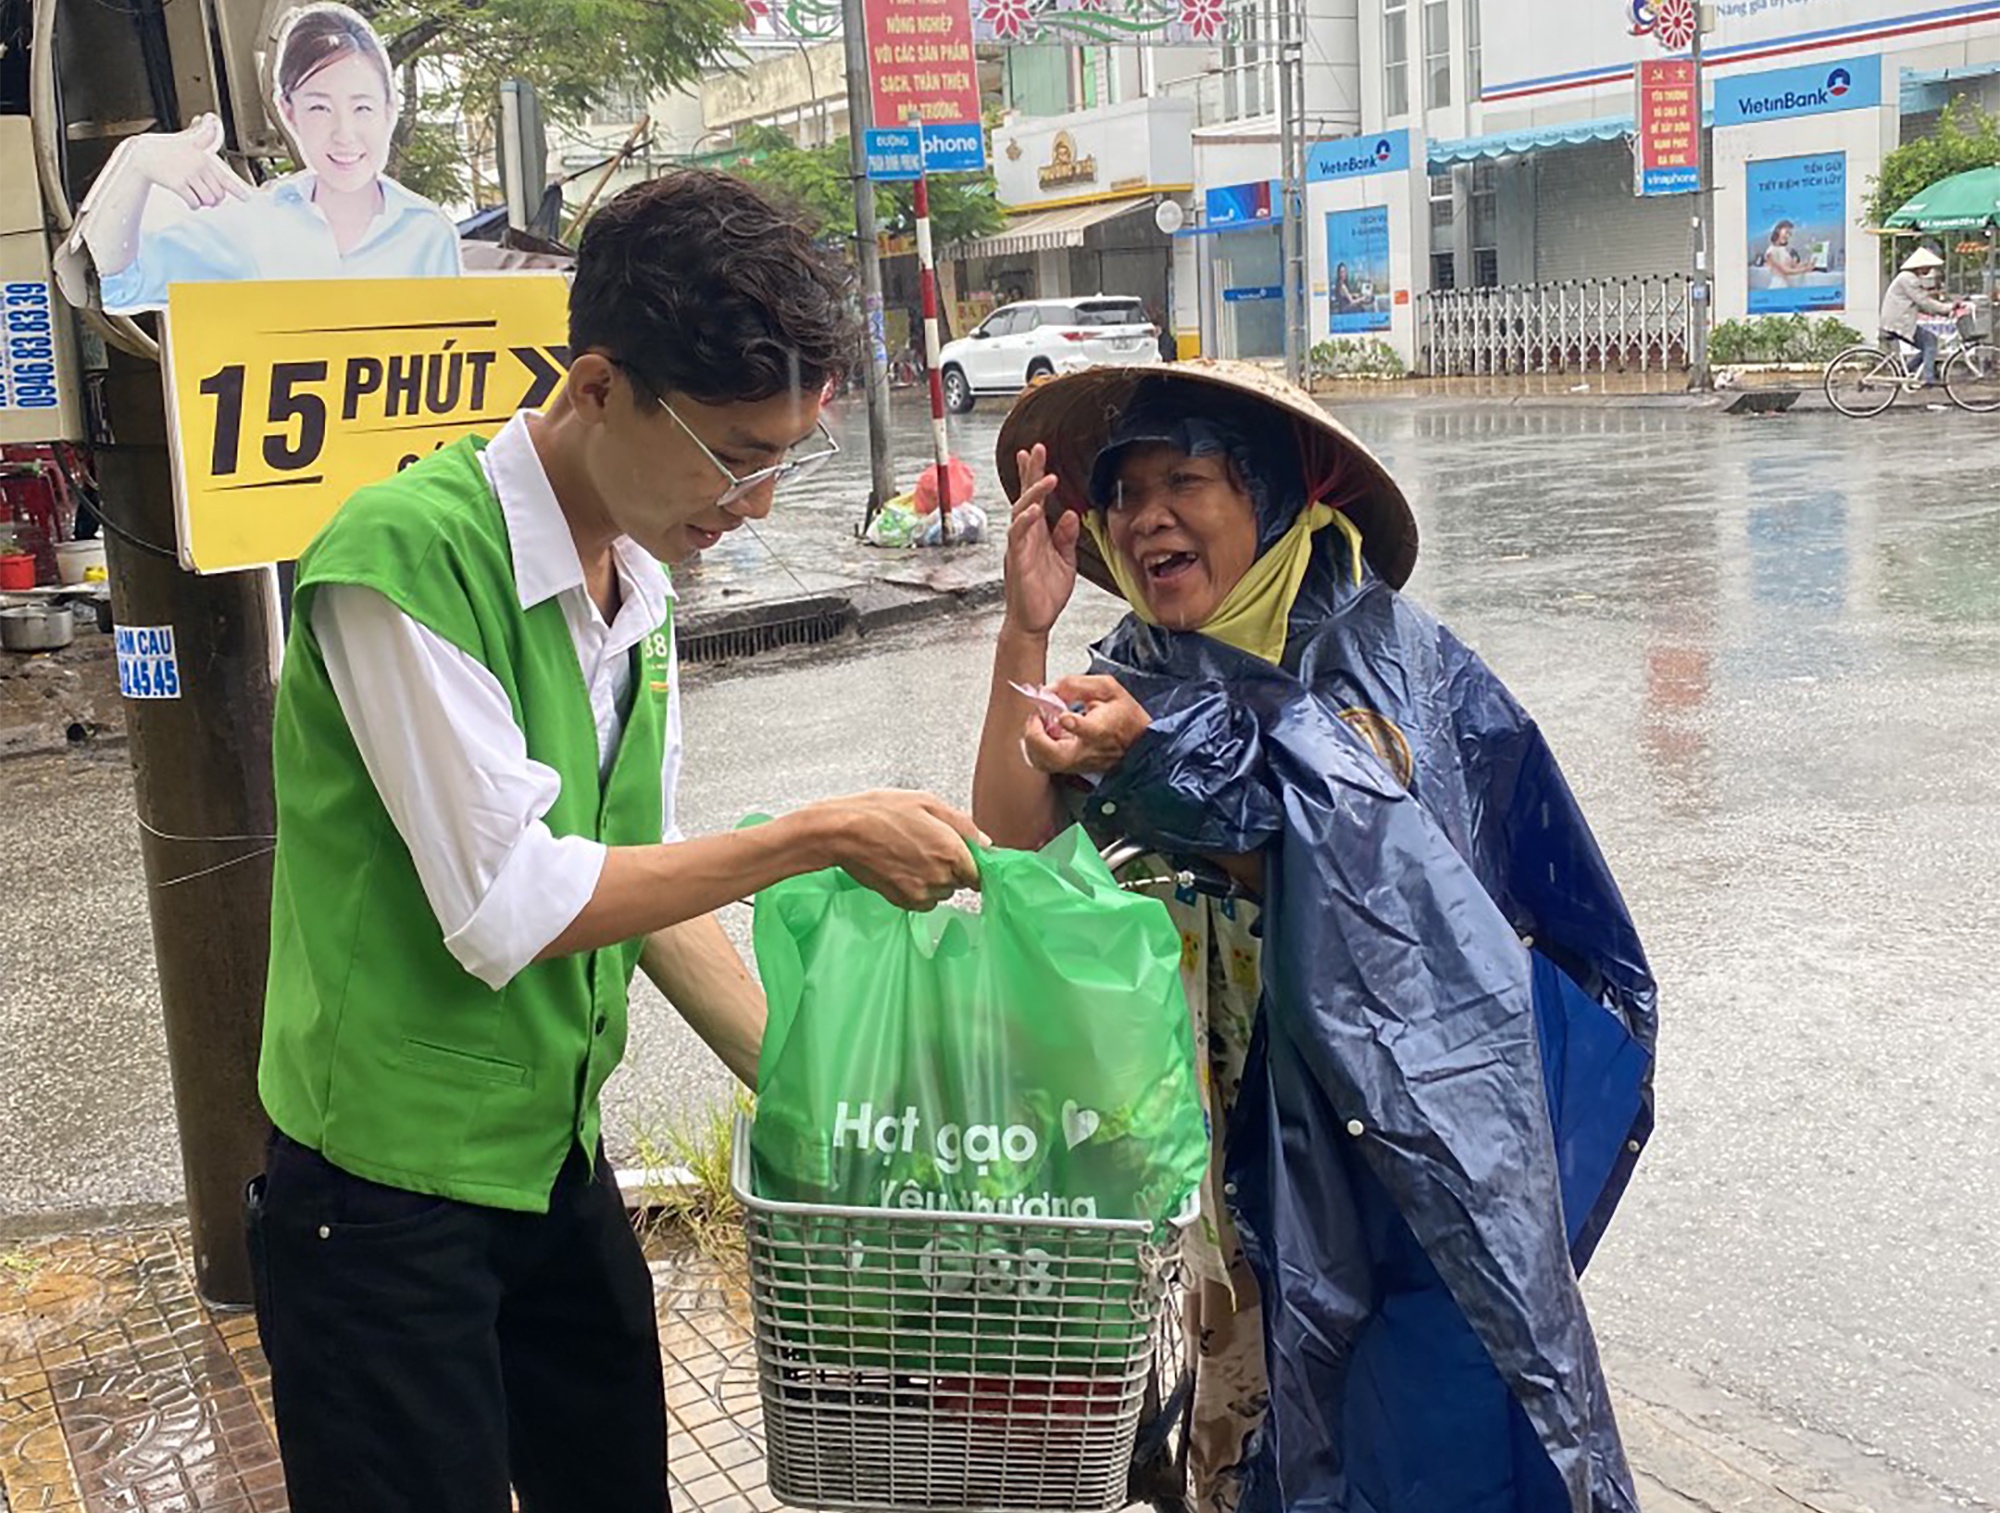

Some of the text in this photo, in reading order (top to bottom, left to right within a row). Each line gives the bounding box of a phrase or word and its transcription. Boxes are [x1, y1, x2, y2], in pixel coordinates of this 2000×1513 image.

[1738, 88, 1828, 115] VietinBank
[923, 135, 978, 154] phone
[1319, 157, 1378, 175] VietinBank
[5, 283, 58, 408] 0946.83.83.39
[199, 339, 497, 477] 15 PHÚT
[832, 1101, 1038, 1176] Hạt gạo
